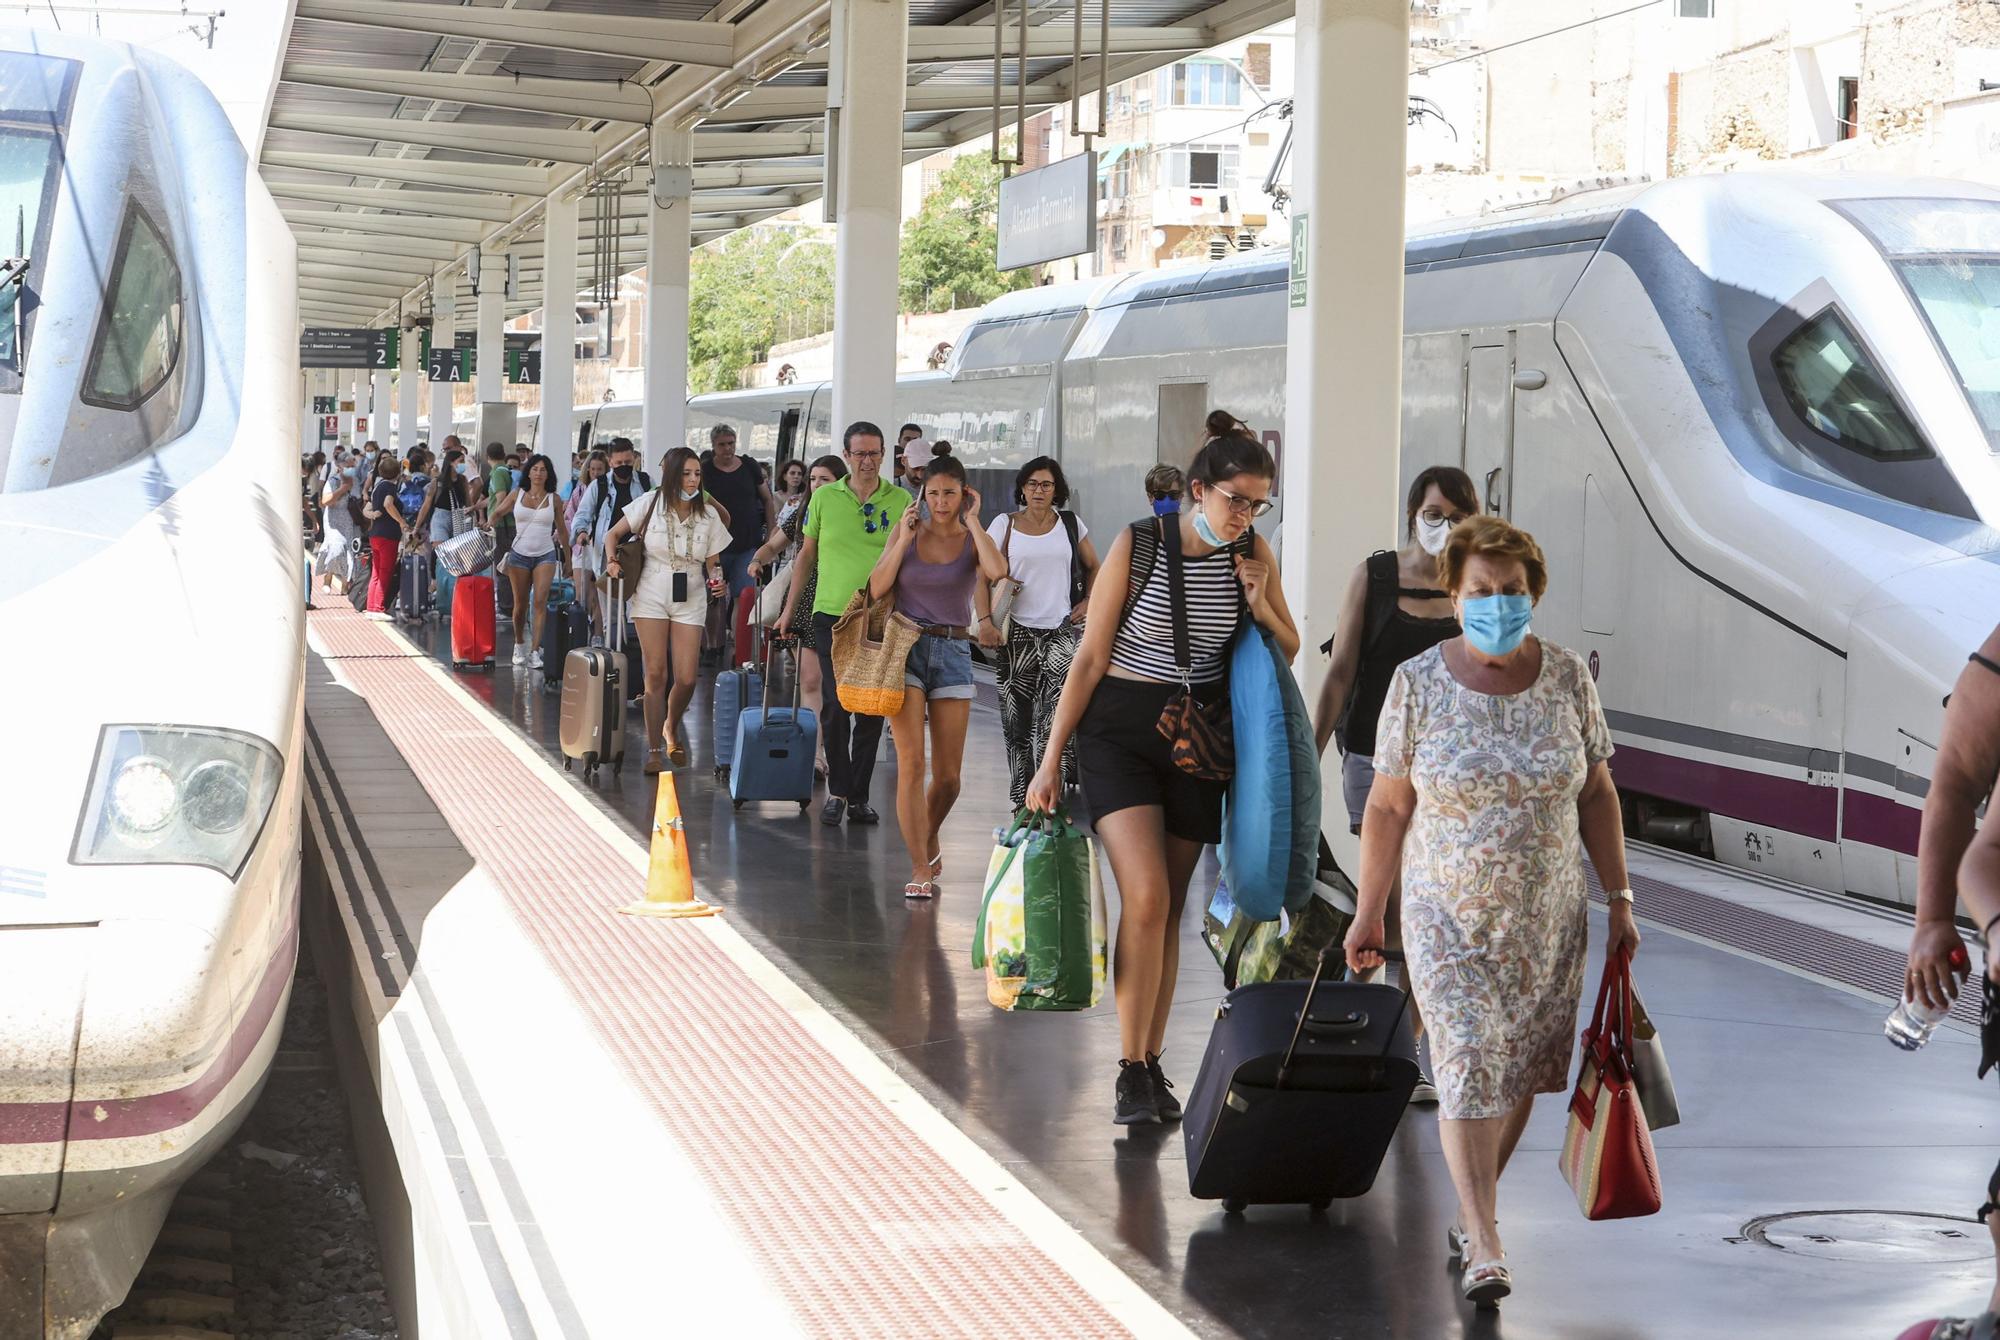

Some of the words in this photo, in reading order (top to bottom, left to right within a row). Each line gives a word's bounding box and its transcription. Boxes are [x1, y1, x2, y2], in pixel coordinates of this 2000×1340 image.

[1041, 184, 1076, 229] Terminal
[1291, 281, 1306, 296] SALIDA
[376, 349, 386, 365] 2
[431, 364, 441, 380] 2
[449, 365, 460, 381] A
[518, 366, 530, 382] A
[315, 404, 321, 413] 2
[324, 404, 330, 413] A
[1590, 656, 1598, 678] 17
